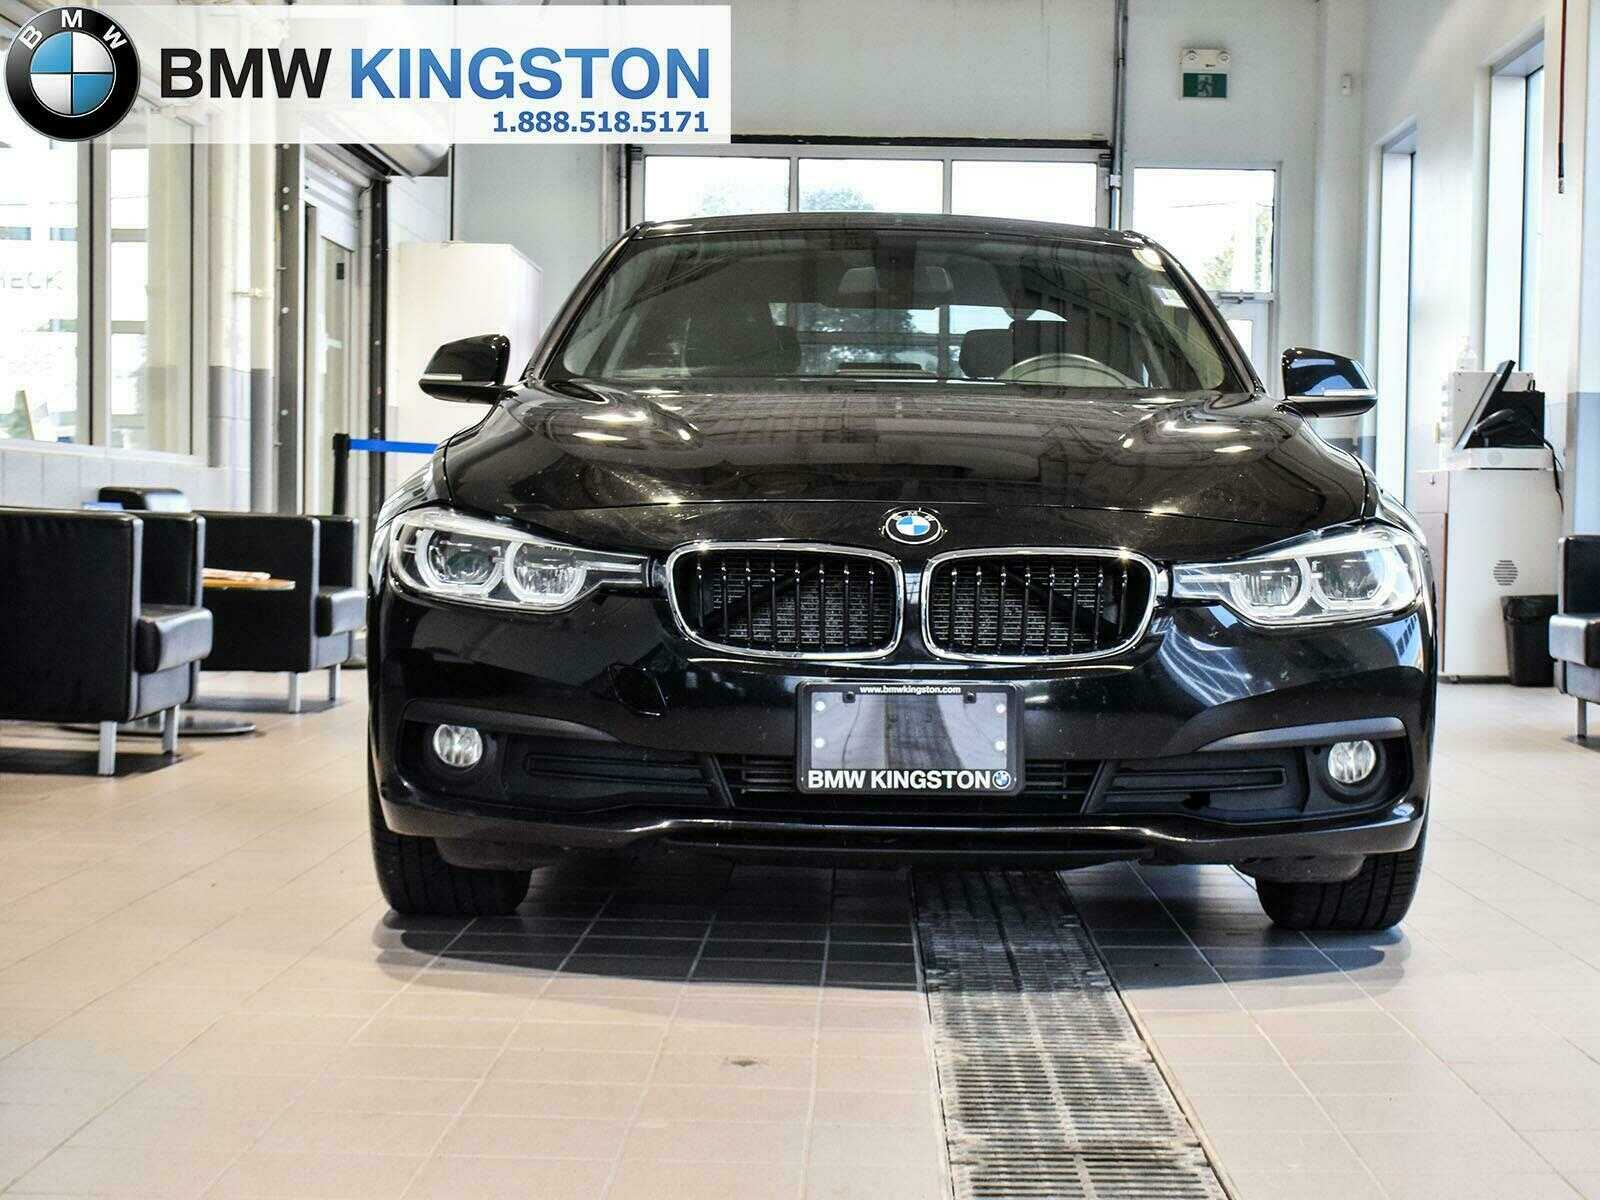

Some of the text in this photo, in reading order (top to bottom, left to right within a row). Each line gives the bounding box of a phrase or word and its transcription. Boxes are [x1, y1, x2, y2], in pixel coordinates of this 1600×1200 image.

[860, 685, 961, 695] www.bmwkingston.com
[807, 769, 866, 789] BMW
[870, 769, 991, 790] KINGSTON
